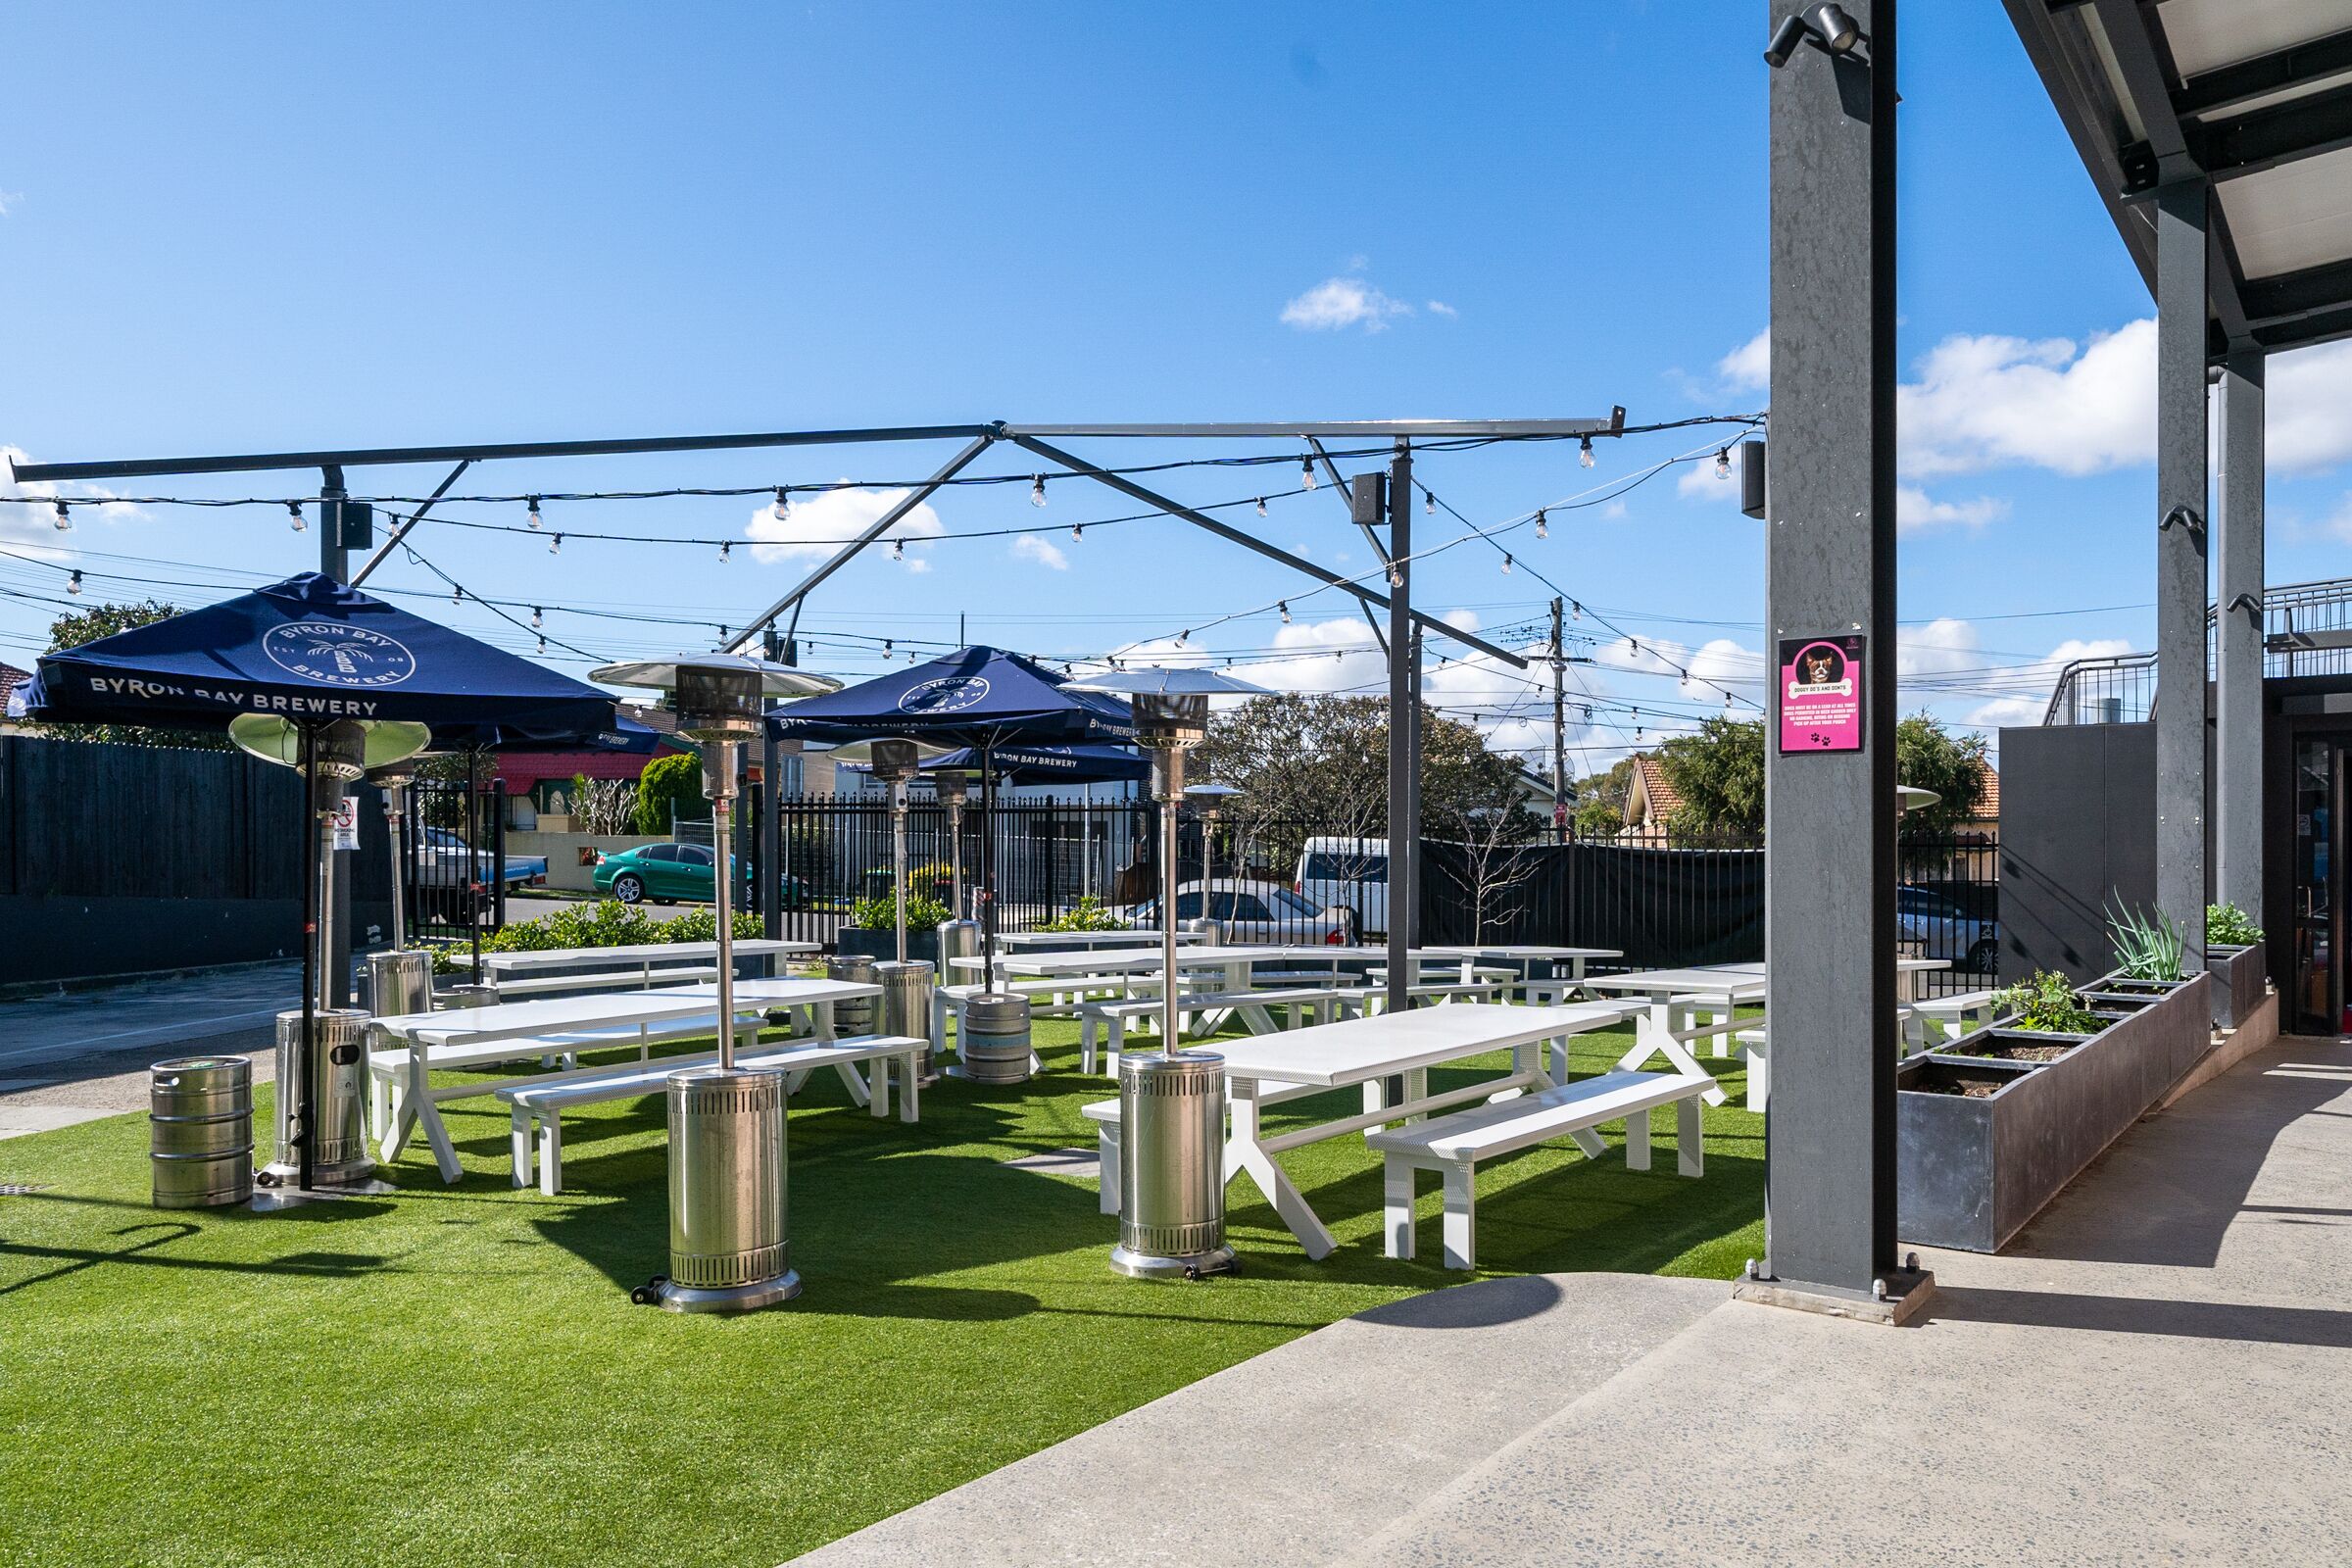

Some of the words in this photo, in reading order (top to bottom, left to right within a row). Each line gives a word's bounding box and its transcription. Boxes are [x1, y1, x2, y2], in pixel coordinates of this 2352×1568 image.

[278, 625, 345, 638] BYRON
[352, 630, 392, 647] BAY
[292, 664, 401, 684] BREWERY
[921, 678, 965, 691] BYRON
[966, 678, 985, 688] BAY
[253, 694, 377, 715] BREWERY
[1020, 755, 1038, 763] BAY
[1038, 757, 1077, 768] BREWERY
